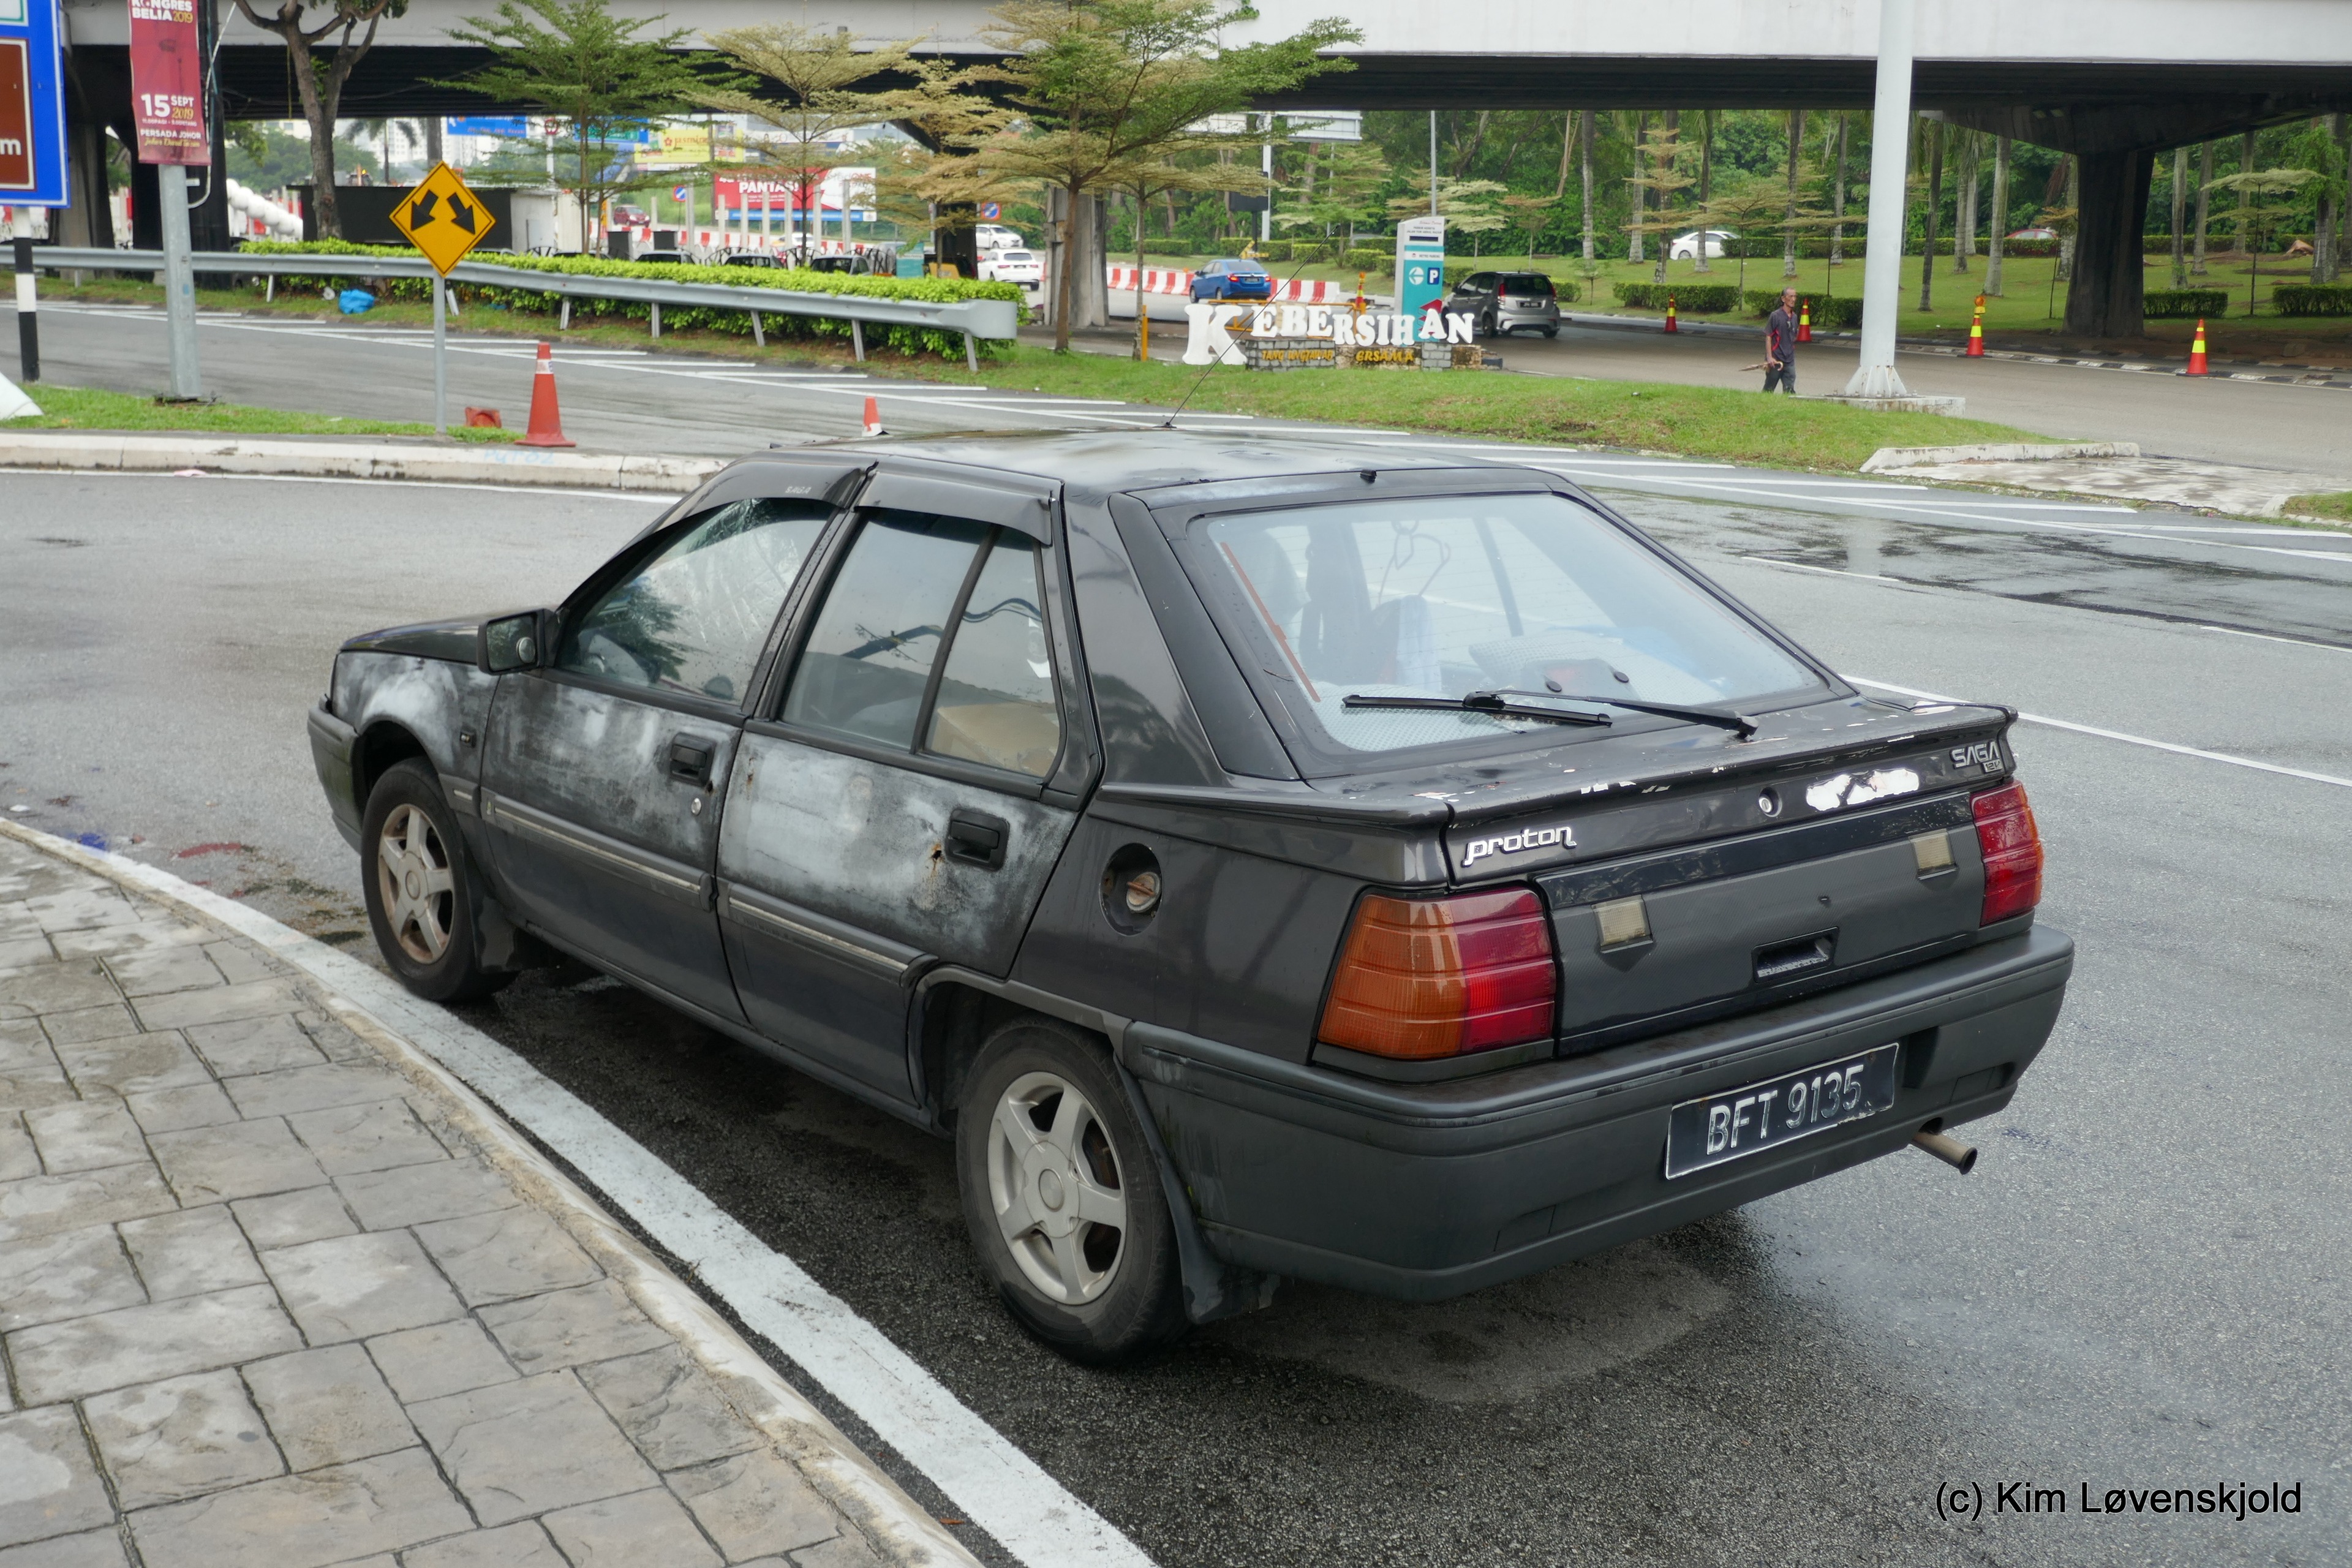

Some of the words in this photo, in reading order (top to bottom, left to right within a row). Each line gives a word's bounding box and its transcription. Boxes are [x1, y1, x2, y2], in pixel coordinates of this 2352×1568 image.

[132, 7, 173, 21] BELIA
[173, 10, 194, 23] 2019
[141, 94, 170, 118] 15
[171, 95, 194, 107] SEPT
[172, 107, 194, 120] 2019
[140, 129, 178, 138] PERSADA
[179, 130, 202, 140] JOHOR
[739, 181, 799, 193] PANTAS!
[1429, 270, 1439, 284] P
[1182, 303, 1475, 366] KEBERSIHAN
[1951, 741, 2000, 768] SAGA
[1985, 760, 2000, 771] 12V
[1462, 826, 1578, 867] proton
[1706, 1090, 1778, 1156] BFT
[1786, 1065, 1864, 1129] 9135
